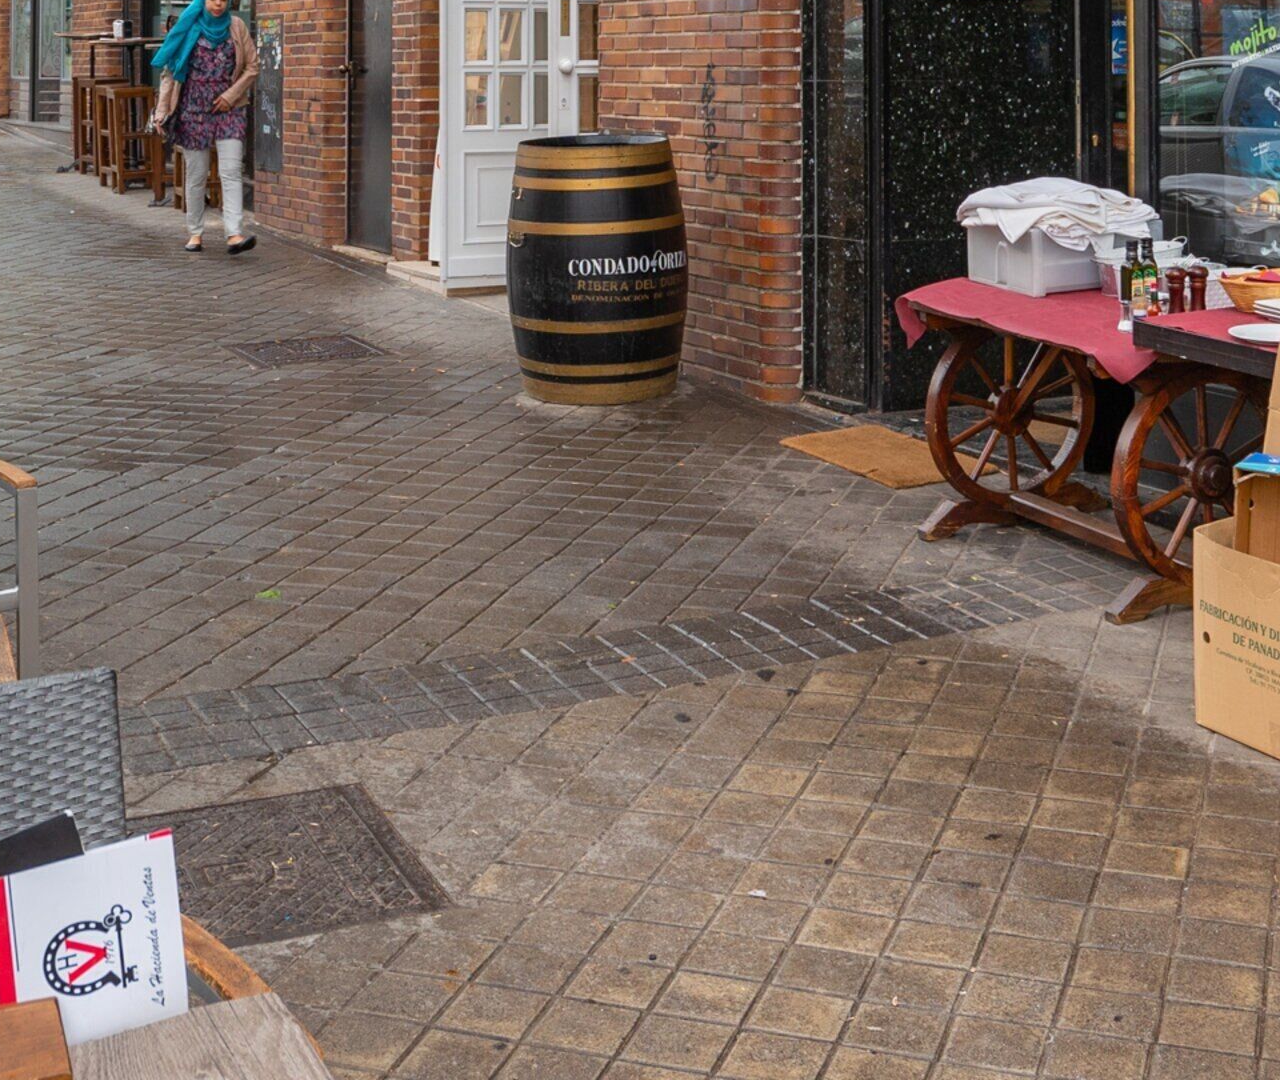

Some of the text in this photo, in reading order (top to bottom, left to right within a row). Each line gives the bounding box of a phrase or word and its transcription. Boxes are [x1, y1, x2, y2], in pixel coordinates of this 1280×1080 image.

[1230, 18, 1277, 56] mojito
[568, 255, 650, 277] CONDADO
[577, 279, 656, 293] RIBERA DEL
[1199, 599, 1260, 633] FABRICACIÓN
[1260, 624, 1268, 636] Y
[1232, 632, 1245, 647] DE
[142, 867, 166, 1007] La Hacienda de Ventas
[57, 953, 78, 971] H
[64, 937, 107, 987] V
